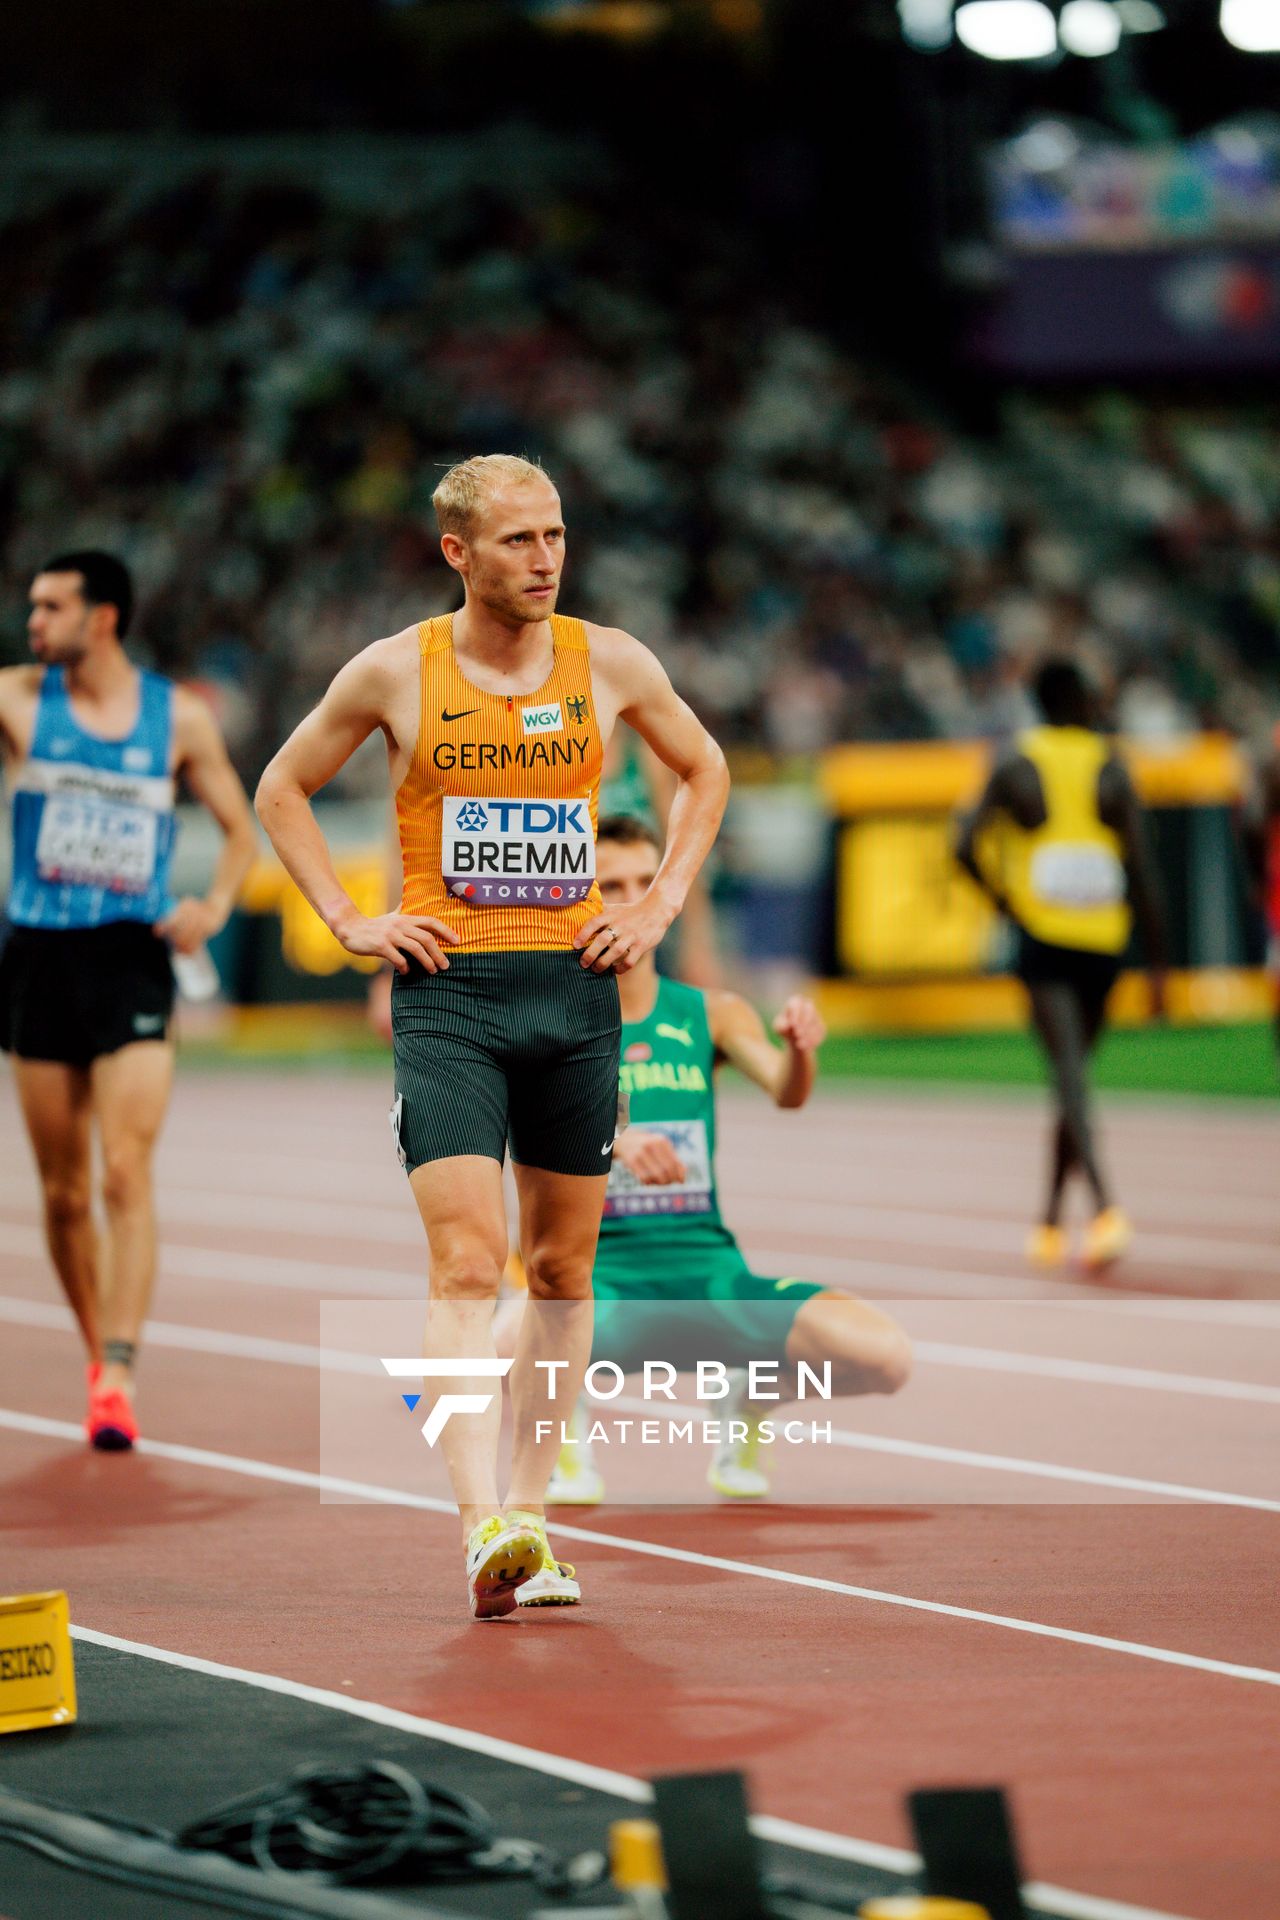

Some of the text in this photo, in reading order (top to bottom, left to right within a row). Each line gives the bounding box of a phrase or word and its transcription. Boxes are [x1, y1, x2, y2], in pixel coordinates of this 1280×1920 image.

[523, 709, 560, 728] WGV
[433, 736, 589, 770] GERMANY
[488, 803, 586, 833] TDK
[453, 841, 587, 873] BREMM
[619, 1062, 707, 1091] TRALIA
